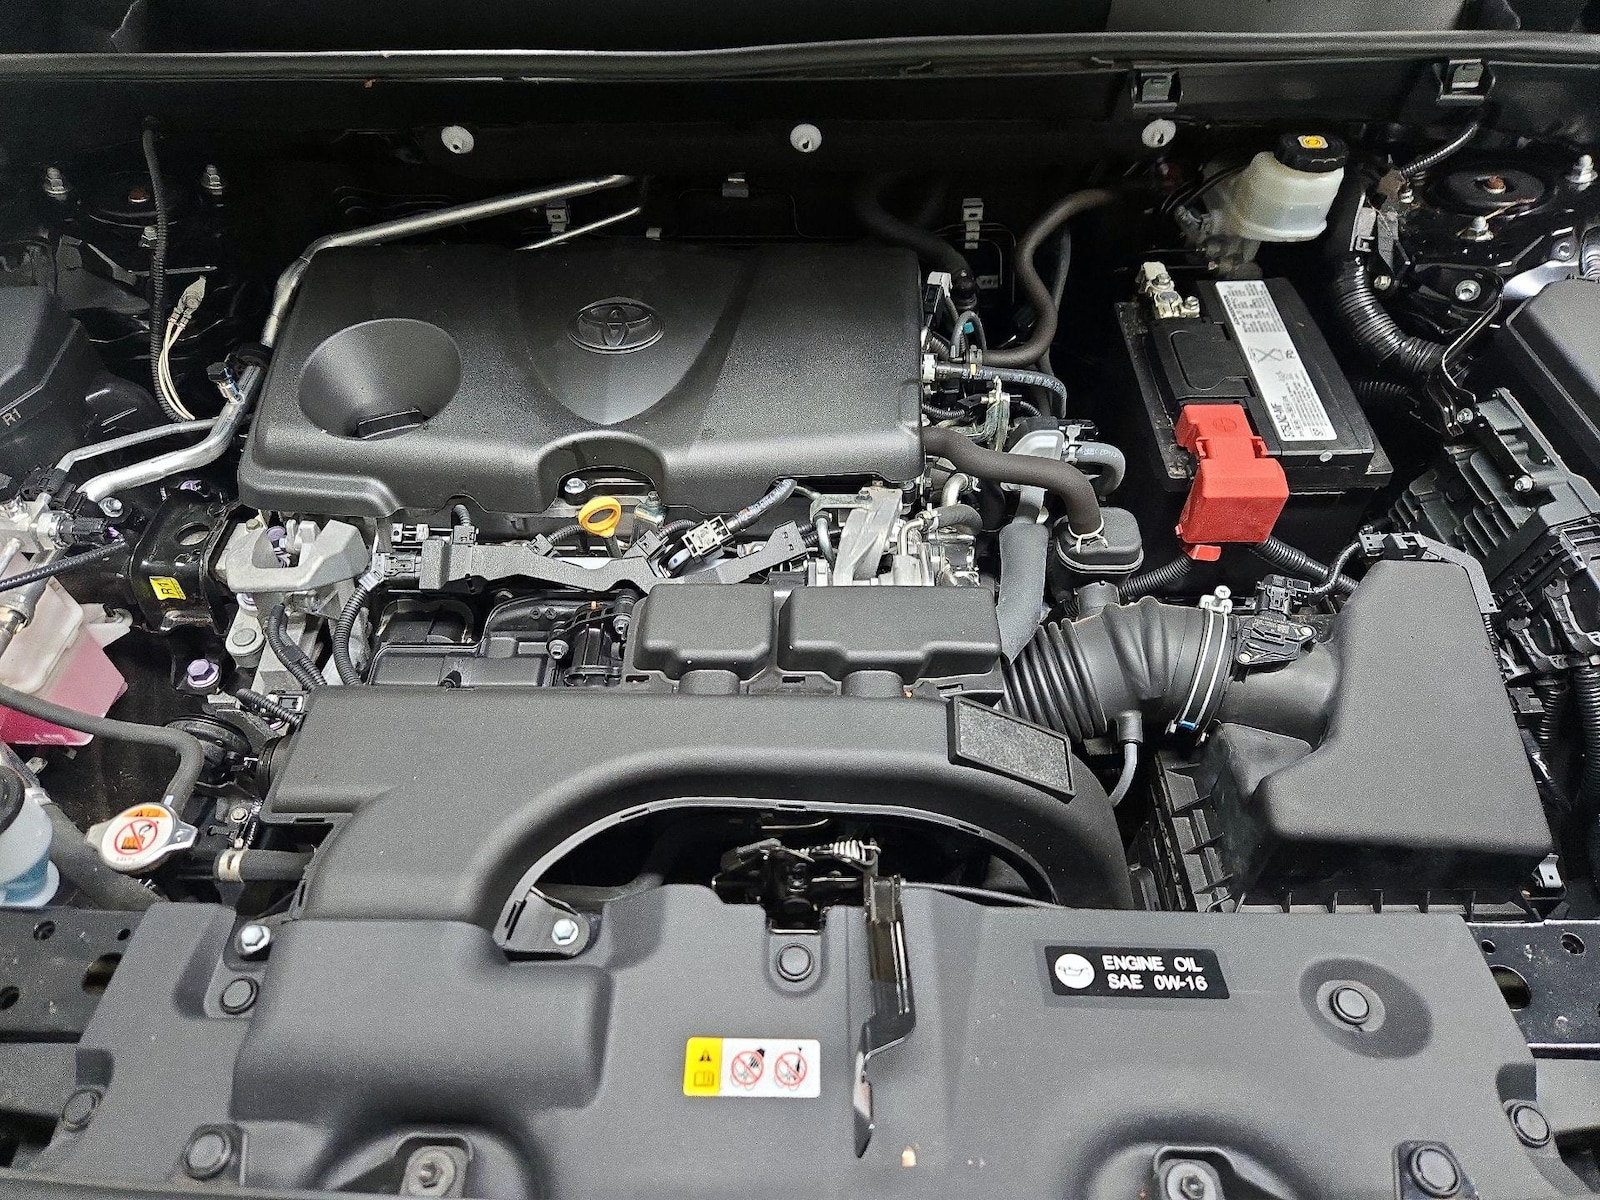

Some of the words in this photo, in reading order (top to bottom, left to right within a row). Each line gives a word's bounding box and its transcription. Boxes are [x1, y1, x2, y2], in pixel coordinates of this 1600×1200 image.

[2, 408, 22, 427] R1
[1101, 954, 1165, 972] ENGINE
[1173, 956, 1204, 973] OIL
[1107, 973, 1144, 990] SAE
[1153, 975, 1208, 991] 0W-16
